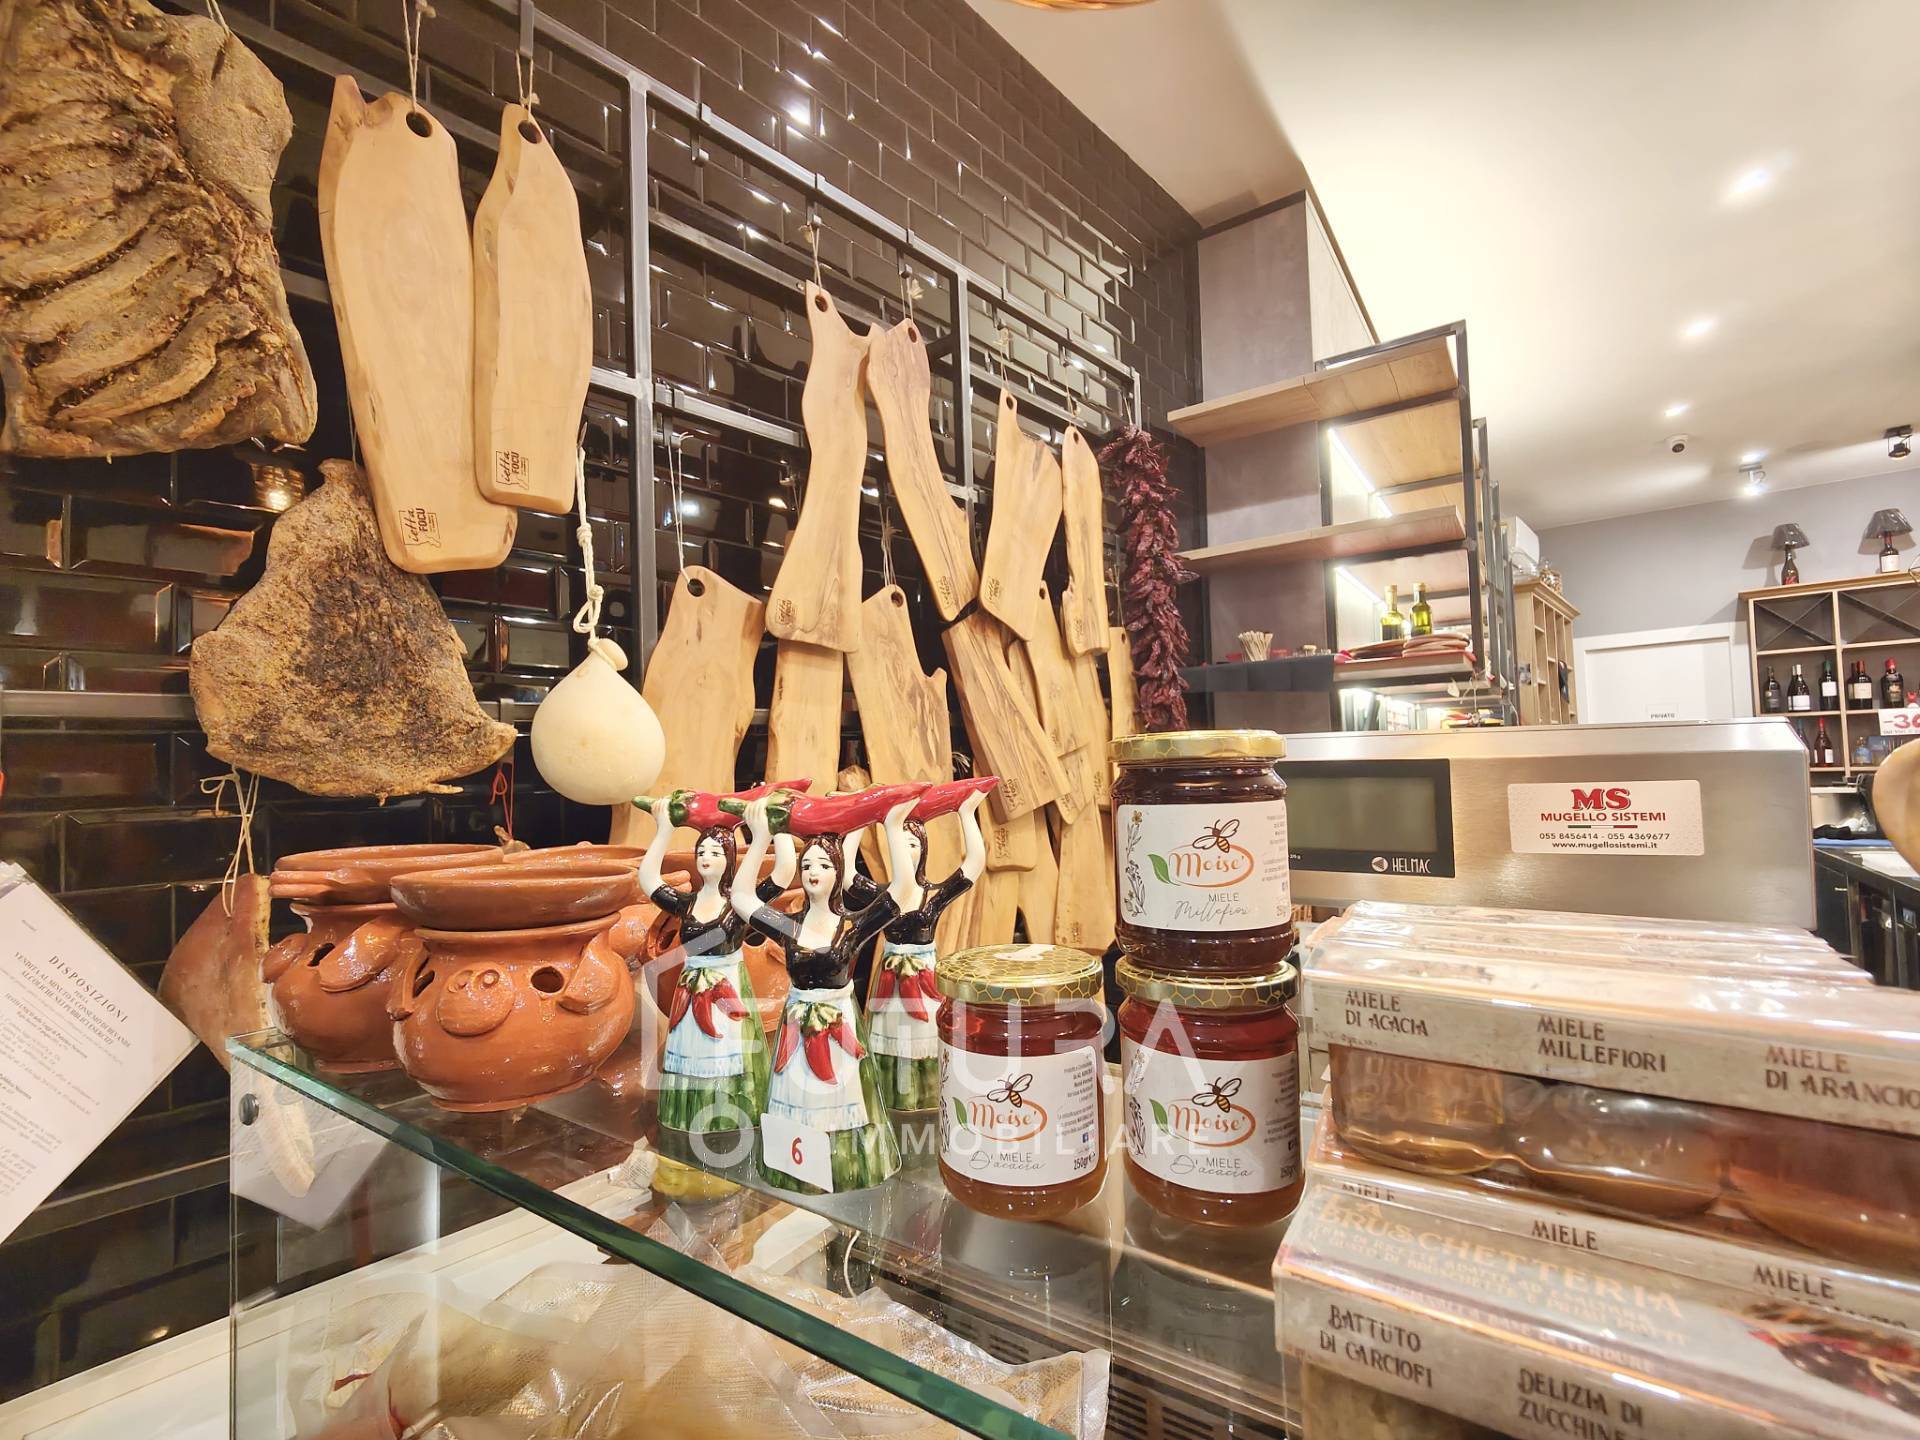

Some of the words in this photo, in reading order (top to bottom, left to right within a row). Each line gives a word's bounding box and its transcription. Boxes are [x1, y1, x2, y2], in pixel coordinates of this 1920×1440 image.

[510, 451, 520, 474] FOCU
[418, 507, 428, 533] FOCU
[1570, 787, 1632, 811] MS
[1540, 812, 1607, 822] MUGELLO
[1611, 812, 1666, 822] SISTEMI
[1552, 841, 1658, 850] www.mugellosistemi.it
[1392, 857, 1432, 874] HELMAC
[1208, 892, 1240, 903] MIELE
[48, 954, 128, 1024] DISPOSIZIONI
[1346, 990, 1400, 1012] MIELE
[1346, 1010, 1362, 1027] DI
[1368, 1013, 1429, 1036] ACACIA
[1537, 1014, 1605, 1042] MIELE
[1538, 1036, 1667, 1074] MILLEFIORI
[1766, 1045, 1850, 1073] MIELE
[1766, 1069, 1788, 1090] DI
[792, 1137, 802, 1165] 6
[1000, 1152, 1032, 1162] MIELE
[1206, 1158, 1240, 1168] MIELE
[1532, 1220, 1599, 1250] MIELE
[1319, 1203, 1683, 1319] BRUSCHETTERIA
[1752, 1264, 1835, 1300] MIELE
[1329, 1304, 1422, 1352] BATTUTO
[1320, 1330, 1337, 1354] DI
[1345, 1340, 1433, 1388] CARCIOFI
[1518, 1368, 1607, 1415] DELIZIA
[1621, 1401, 1644, 1427] DI
